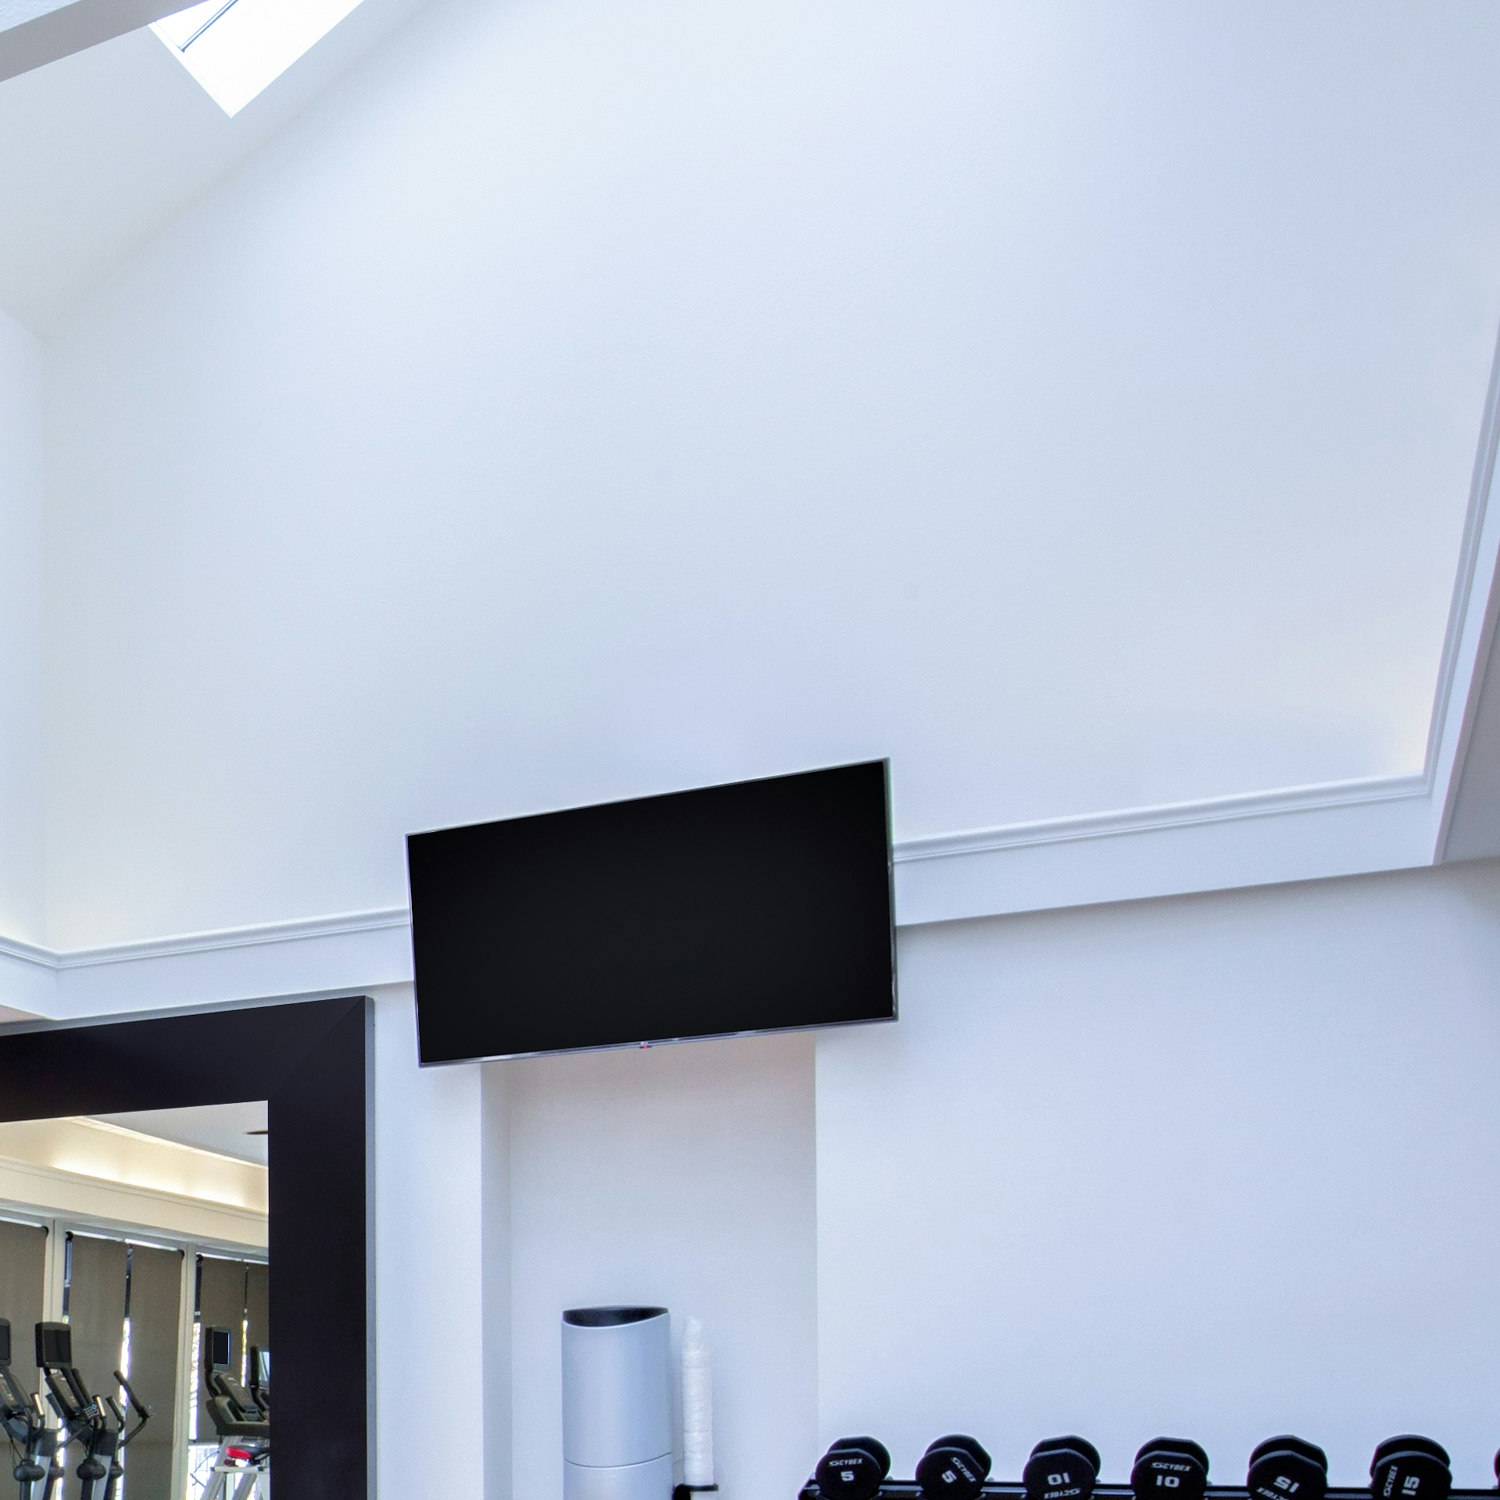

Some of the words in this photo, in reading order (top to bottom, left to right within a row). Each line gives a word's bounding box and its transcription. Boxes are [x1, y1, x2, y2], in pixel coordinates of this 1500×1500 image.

[840, 1471, 855, 1482] 5
[941, 1470, 957, 1484] 5
[1047, 1472, 1071, 1486] 10
[1155, 1475, 1180, 1488] 10
[1273, 1475, 1300, 1494] 15
[1402, 1475, 1420, 1496] 15
